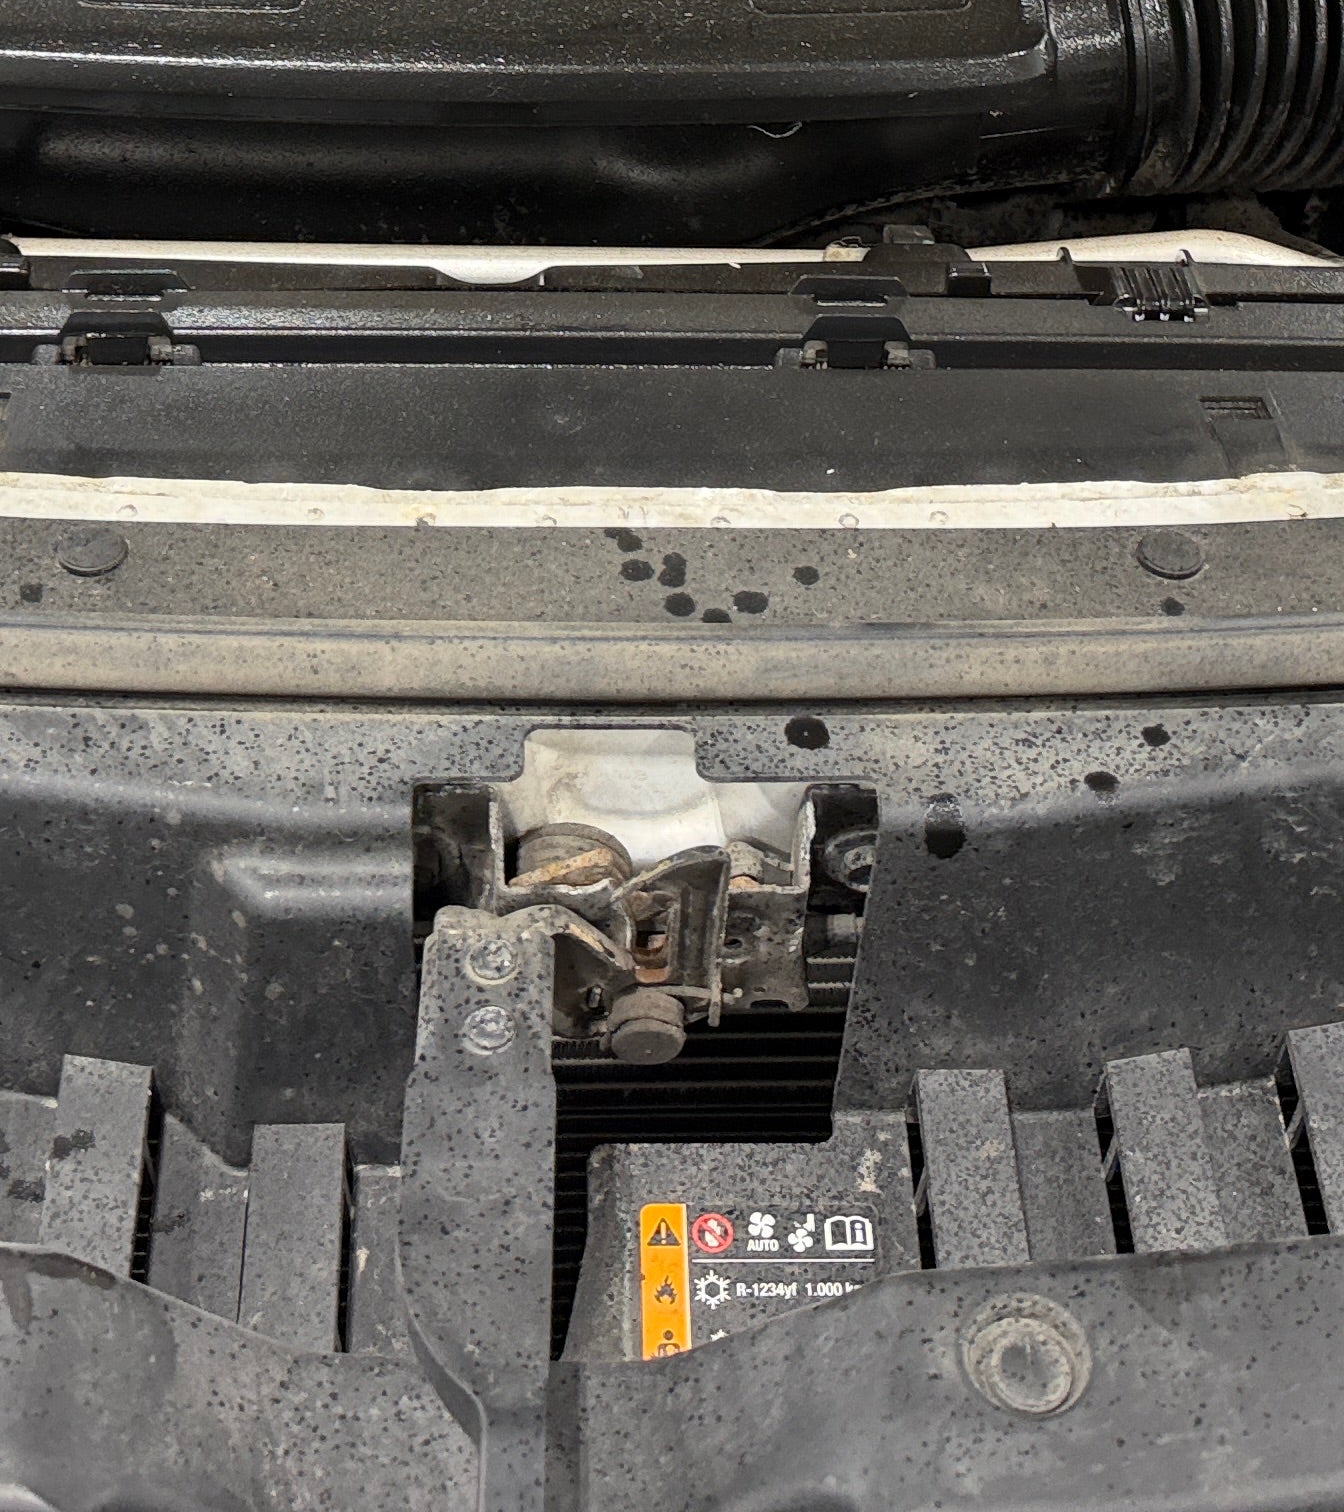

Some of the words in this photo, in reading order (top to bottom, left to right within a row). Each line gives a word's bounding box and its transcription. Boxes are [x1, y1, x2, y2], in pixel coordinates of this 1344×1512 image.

[746, 1239, 779, 1252] AUTO
[736, 1282, 798, 1300] R-1234yf
[805, 1282, 844, 1297] 1.000
